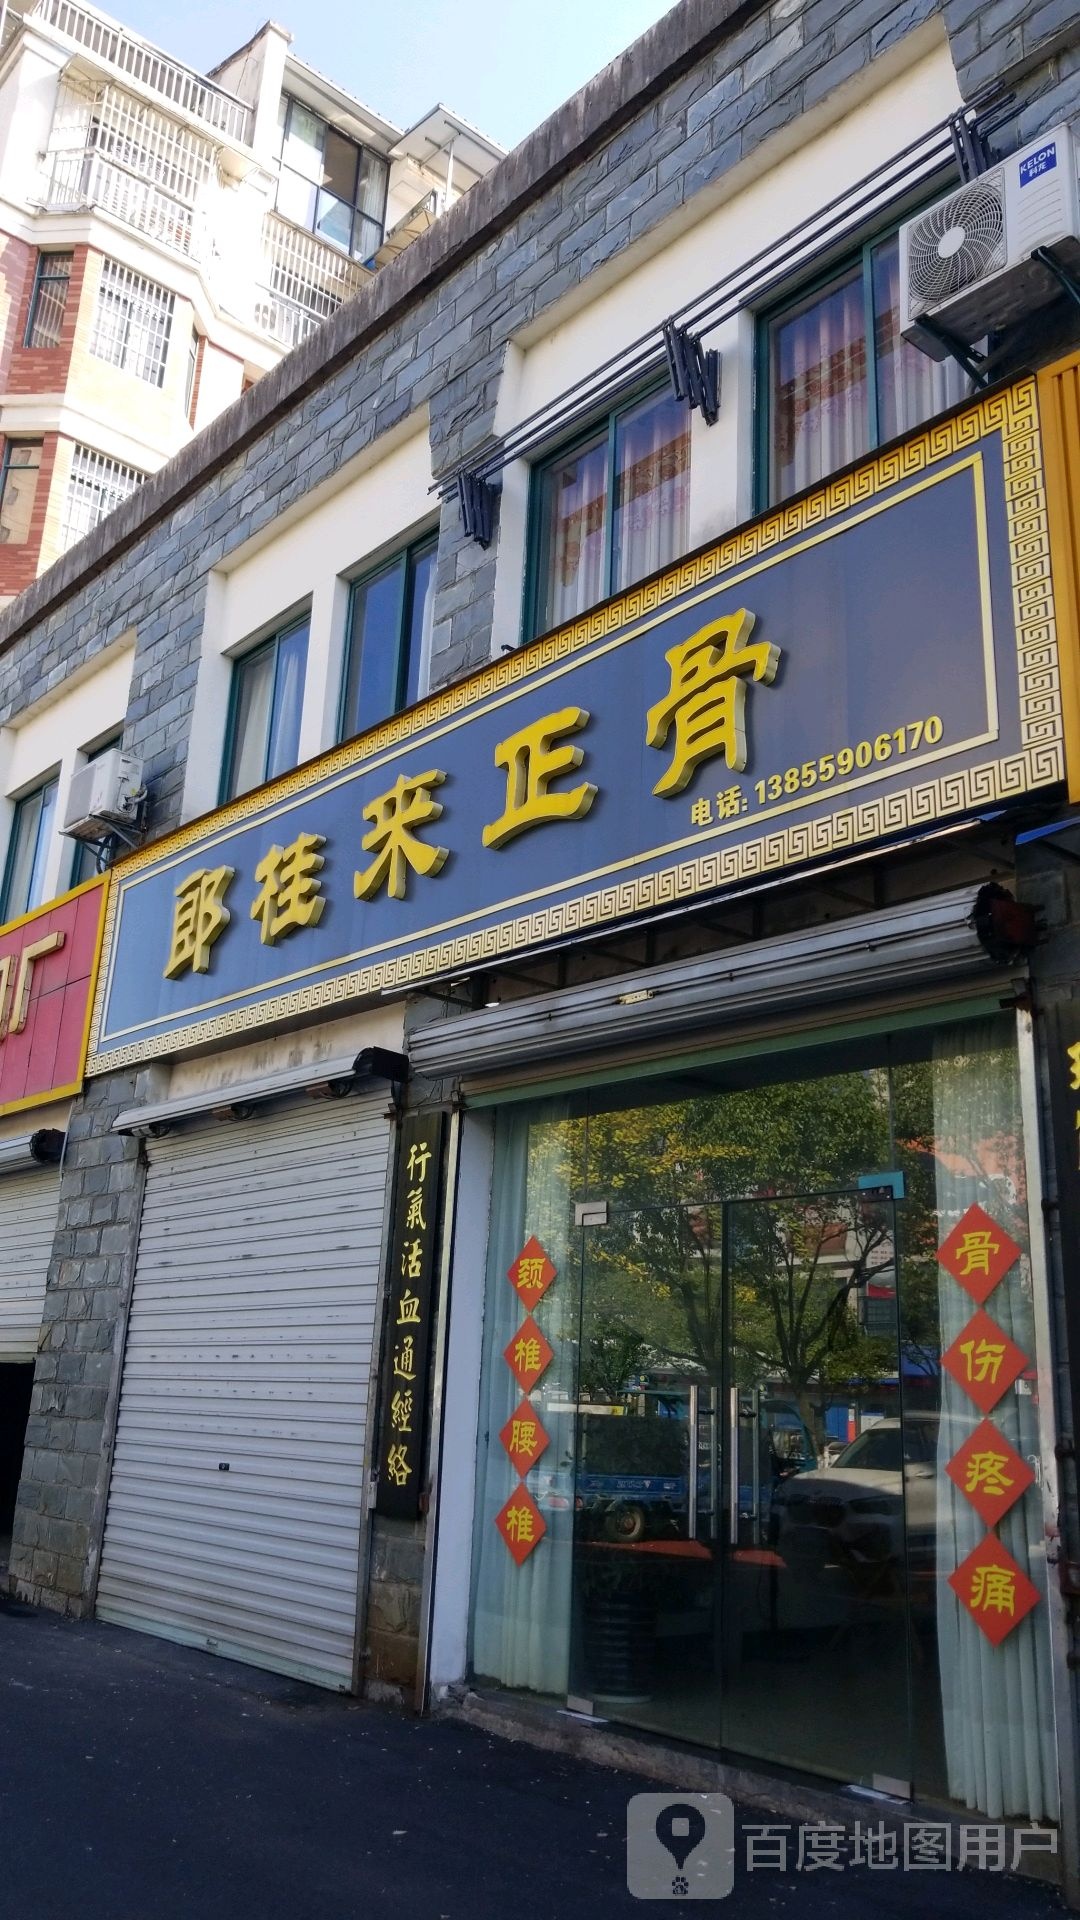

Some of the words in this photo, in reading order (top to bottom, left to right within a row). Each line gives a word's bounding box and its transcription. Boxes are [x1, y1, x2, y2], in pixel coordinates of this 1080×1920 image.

[1020, 147, 1055, 173] KELON
[0, 931, 65, 1042] 厂
[387, 1142, 432, 1486] 行氣活血通經絡
